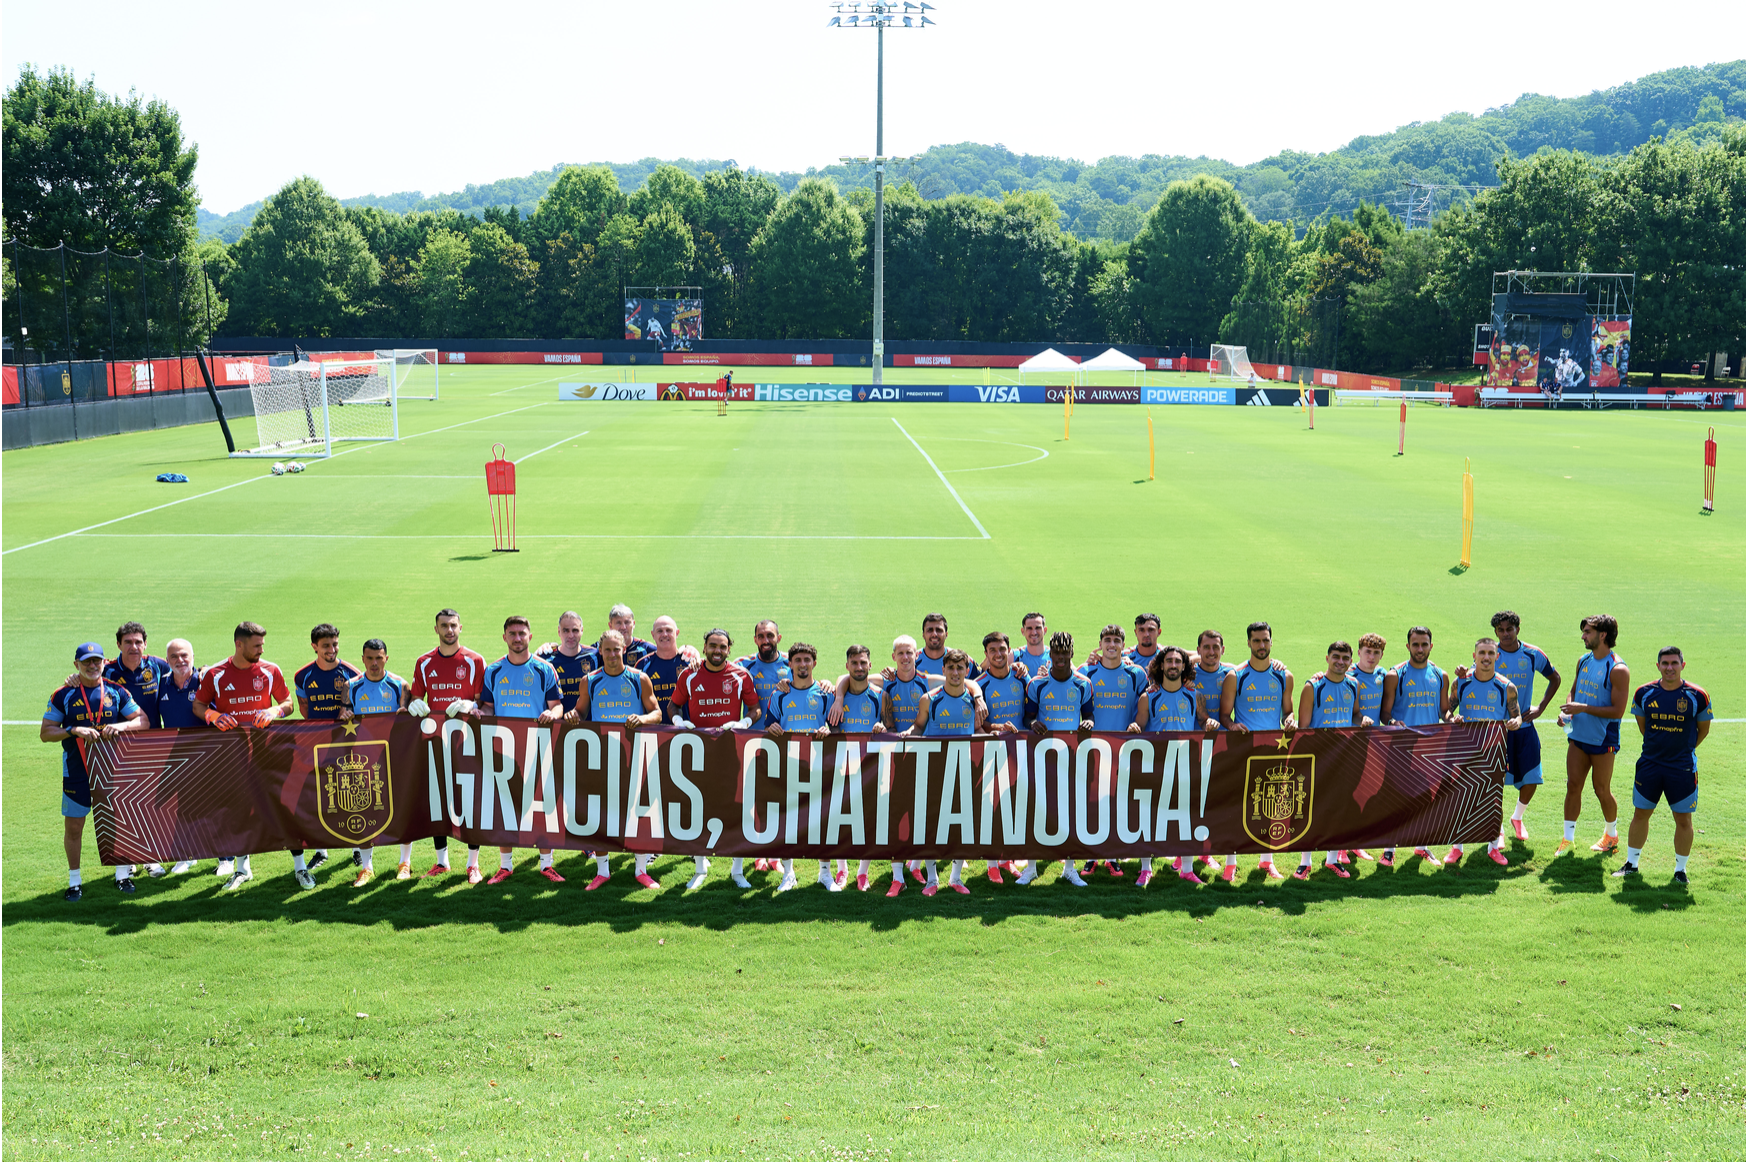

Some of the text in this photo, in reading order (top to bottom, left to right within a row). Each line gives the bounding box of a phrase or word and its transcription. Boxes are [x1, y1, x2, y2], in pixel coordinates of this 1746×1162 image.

[544, 354, 562, 363] VAMOS
[914, 357, 932, 365] VAMOS
[602, 383, 646, 400] Dove
[689, 387, 705, 398] i'm
[754, 384, 852, 401] Hisense
[868, 387, 900, 400] ADI
[974, 386, 1021, 402] VISA
[1090, 390, 1139, 400] AIRWAYS
[1147, 389, 1228, 402] POWERADE
[229, 695, 262, 704] EBRO
[993, 699, 1021, 709] EBRO
[1466, 704, 1495, 712] EBRO
[1651, 713, 1685, 721] EBRO
[420, 717, 1214, 849] ¡GRACIAS, CHATTANOOGA!
